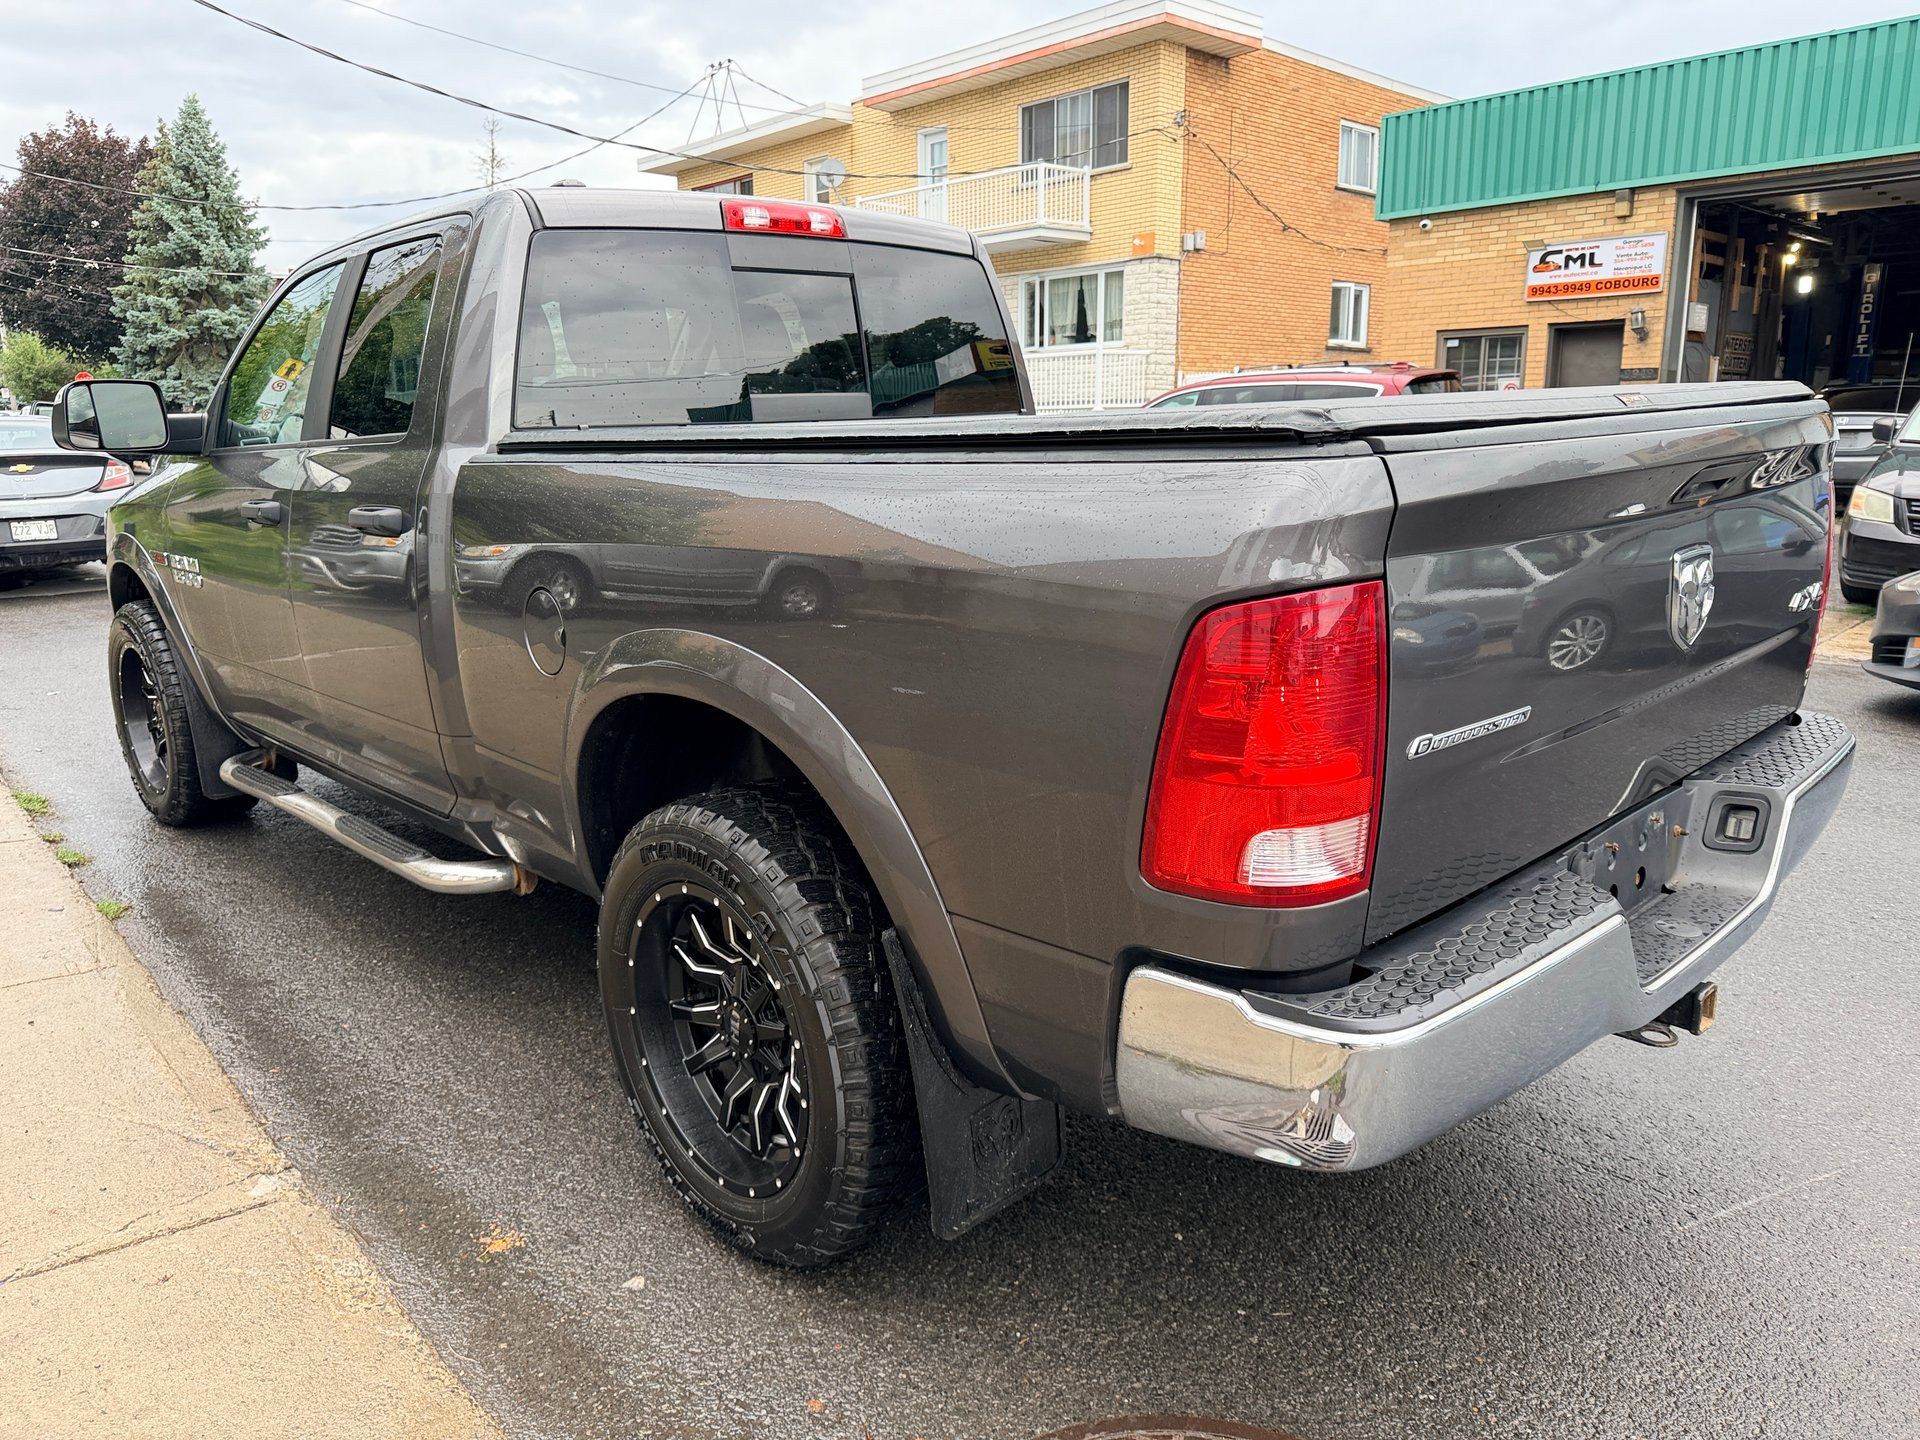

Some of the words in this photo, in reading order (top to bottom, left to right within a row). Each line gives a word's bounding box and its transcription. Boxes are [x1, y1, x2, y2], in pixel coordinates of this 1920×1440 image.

[1531, 282, 1591, 296] 9943-9949
[1595, 276, 1660, 291] COBOURG
[1856, 273, 1879, 355] GIROLIFT
